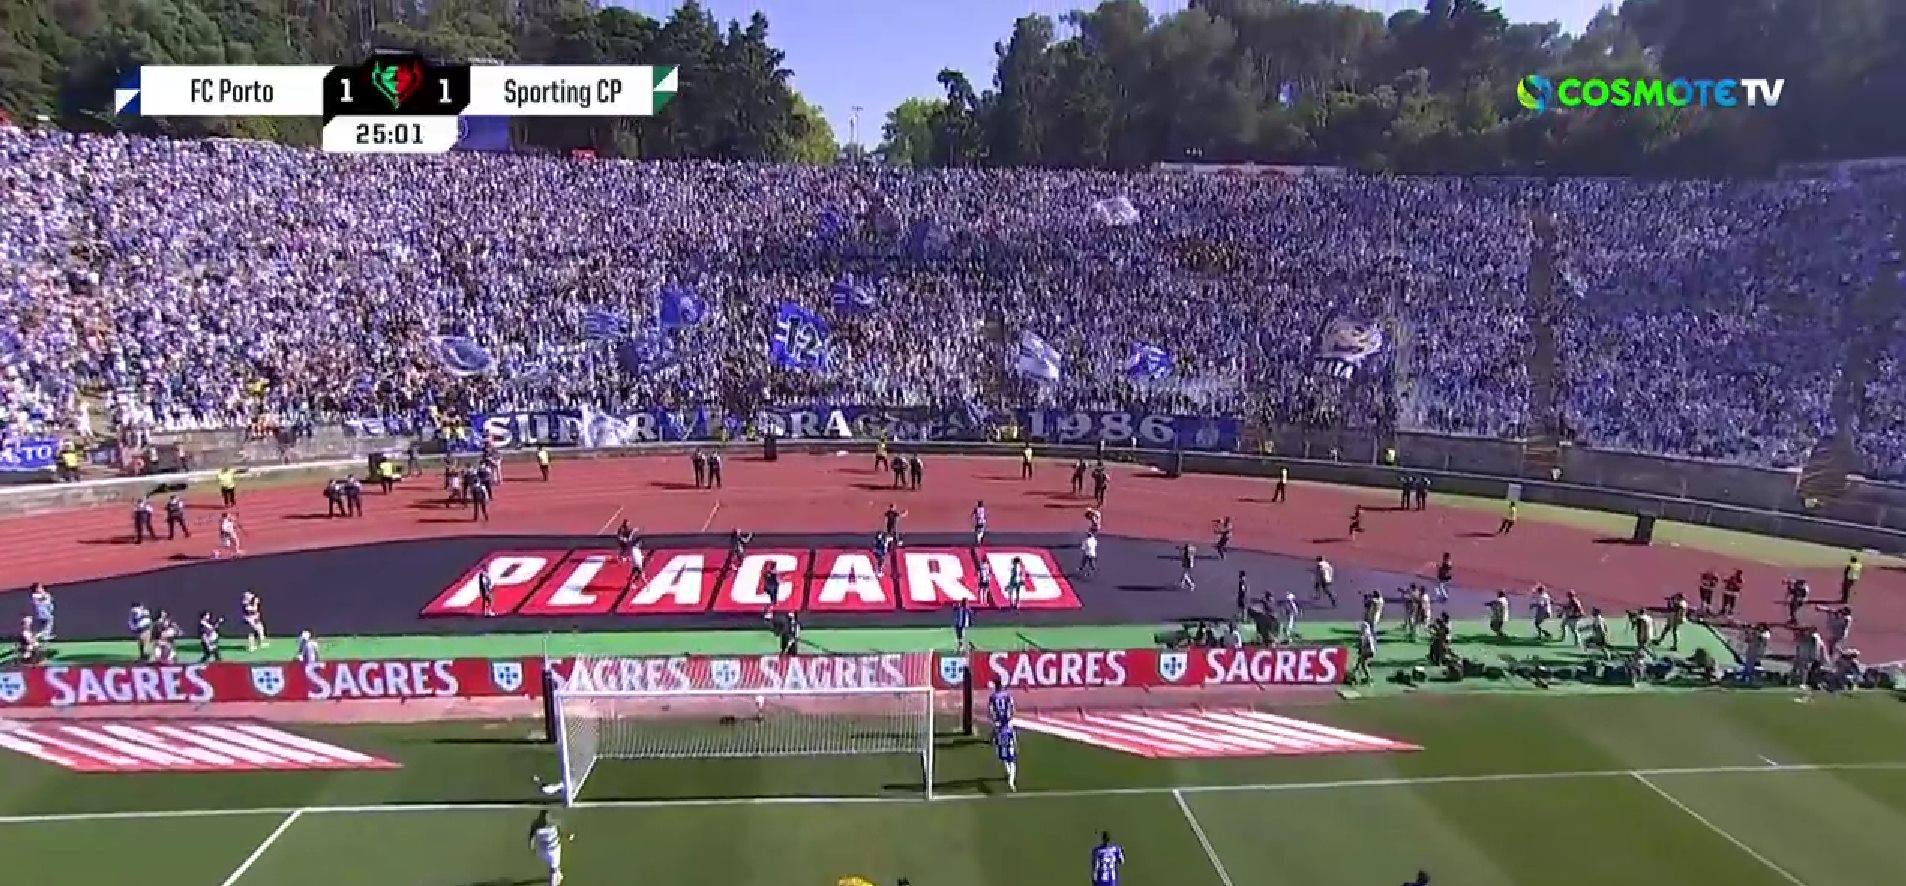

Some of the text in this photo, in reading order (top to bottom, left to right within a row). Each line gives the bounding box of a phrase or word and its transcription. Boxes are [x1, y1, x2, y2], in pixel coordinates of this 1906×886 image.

[1028, 410, 1175, 442] 1986
[441, 552, 1062, 607] PLACARD
[44, 646, 1338, 706] SAGRES SAGRES SAGRES SAGRES SAGRES SAGRES
